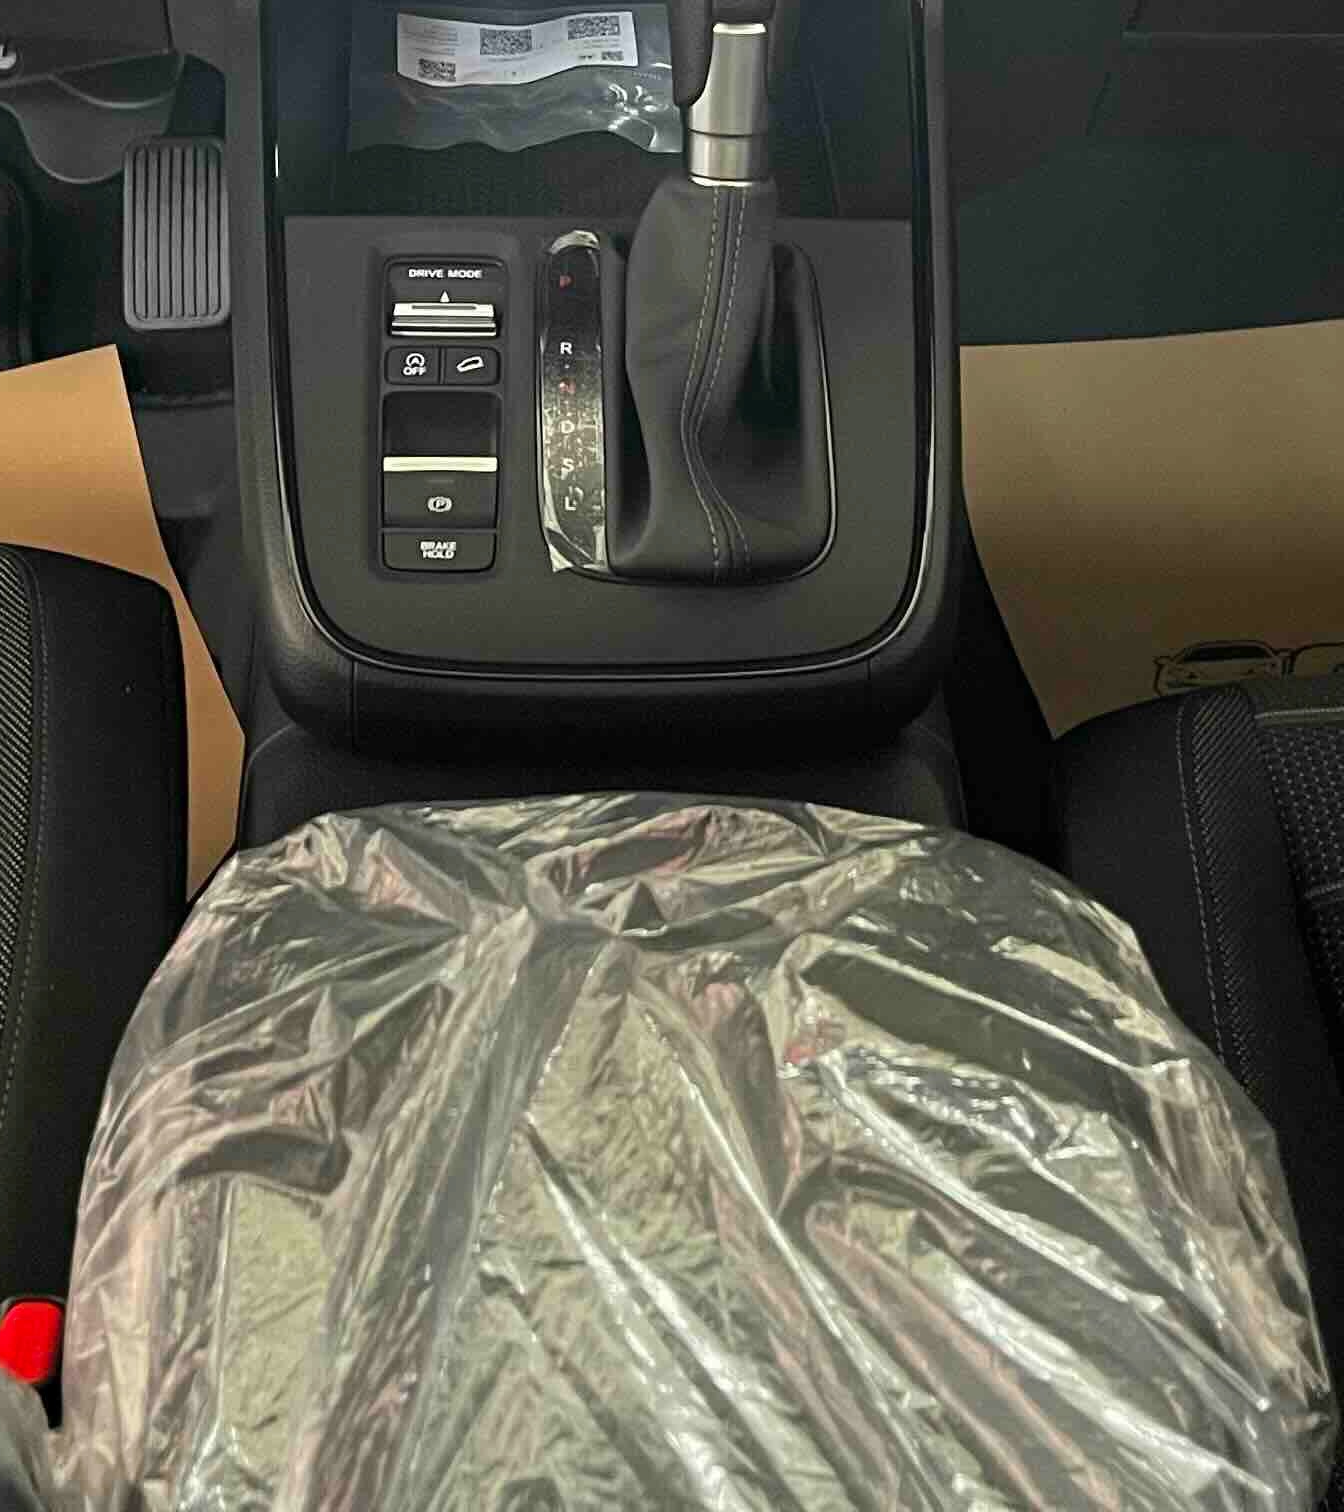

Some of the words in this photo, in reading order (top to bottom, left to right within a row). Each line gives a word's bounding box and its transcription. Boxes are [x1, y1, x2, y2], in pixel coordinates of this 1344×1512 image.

[408, 269, 444, 279] DRIVE
[448, 269, 483, 279] MODE
[560, 342, 573, 355] R
[403, 366, 427, 377] OFF
[560, 420, 575, 434] D
[562, 457, 574, 472] S
[564, 496, 576, 511] L
[420, 541, 457, 551] BRAKE
[422, 550, 455, 559] HOLD
